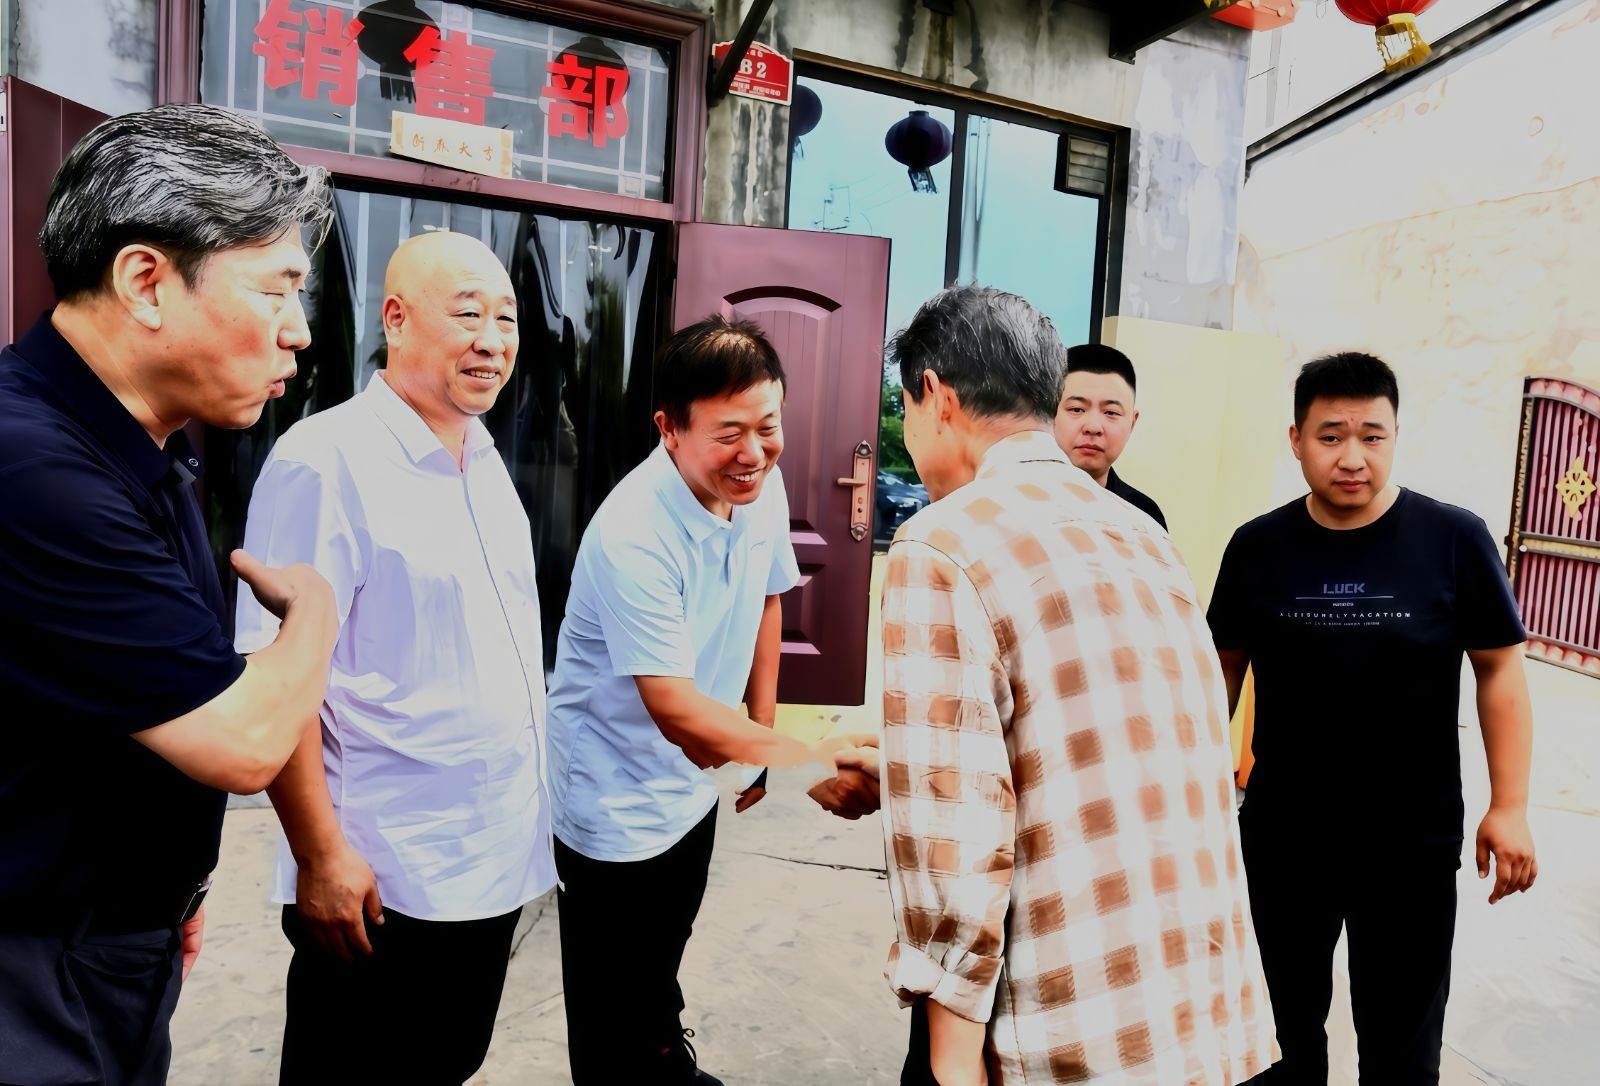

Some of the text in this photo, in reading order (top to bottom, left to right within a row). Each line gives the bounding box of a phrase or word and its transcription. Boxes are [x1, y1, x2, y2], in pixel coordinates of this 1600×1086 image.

[252, 0, 630, 148] 销售部
[1323, 583, 1366, 594] LUCK
